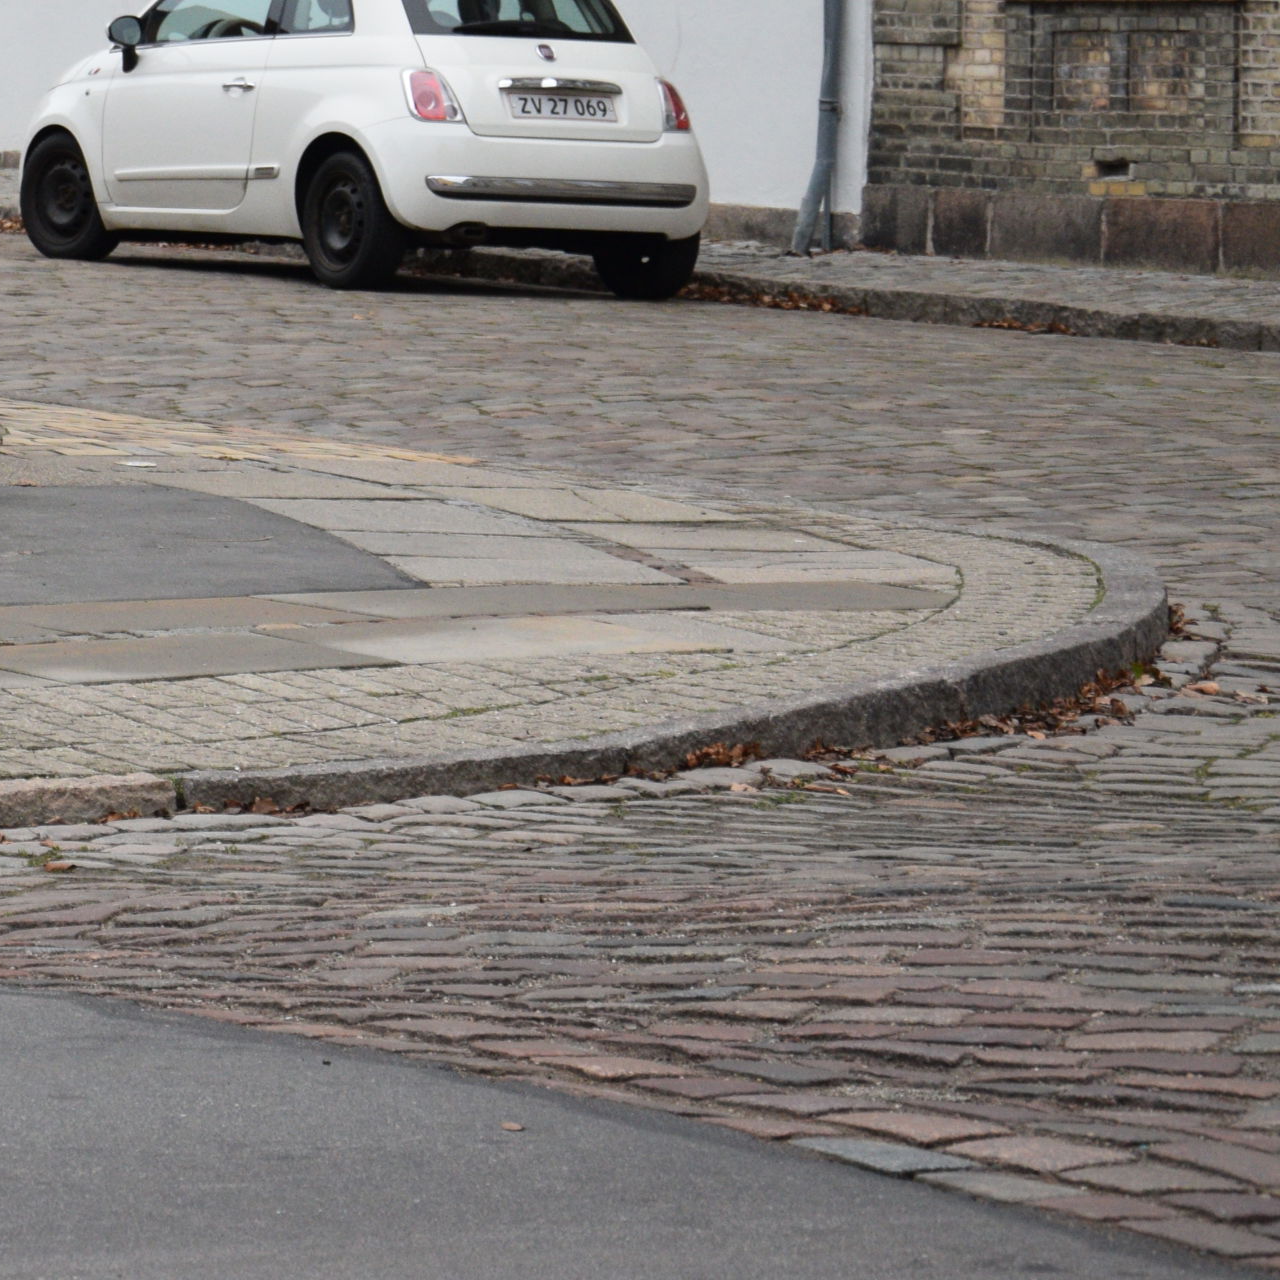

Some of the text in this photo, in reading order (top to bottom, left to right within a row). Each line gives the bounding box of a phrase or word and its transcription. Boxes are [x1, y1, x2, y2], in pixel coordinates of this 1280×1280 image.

[518, 97, 607, 117] ZV 27 069
